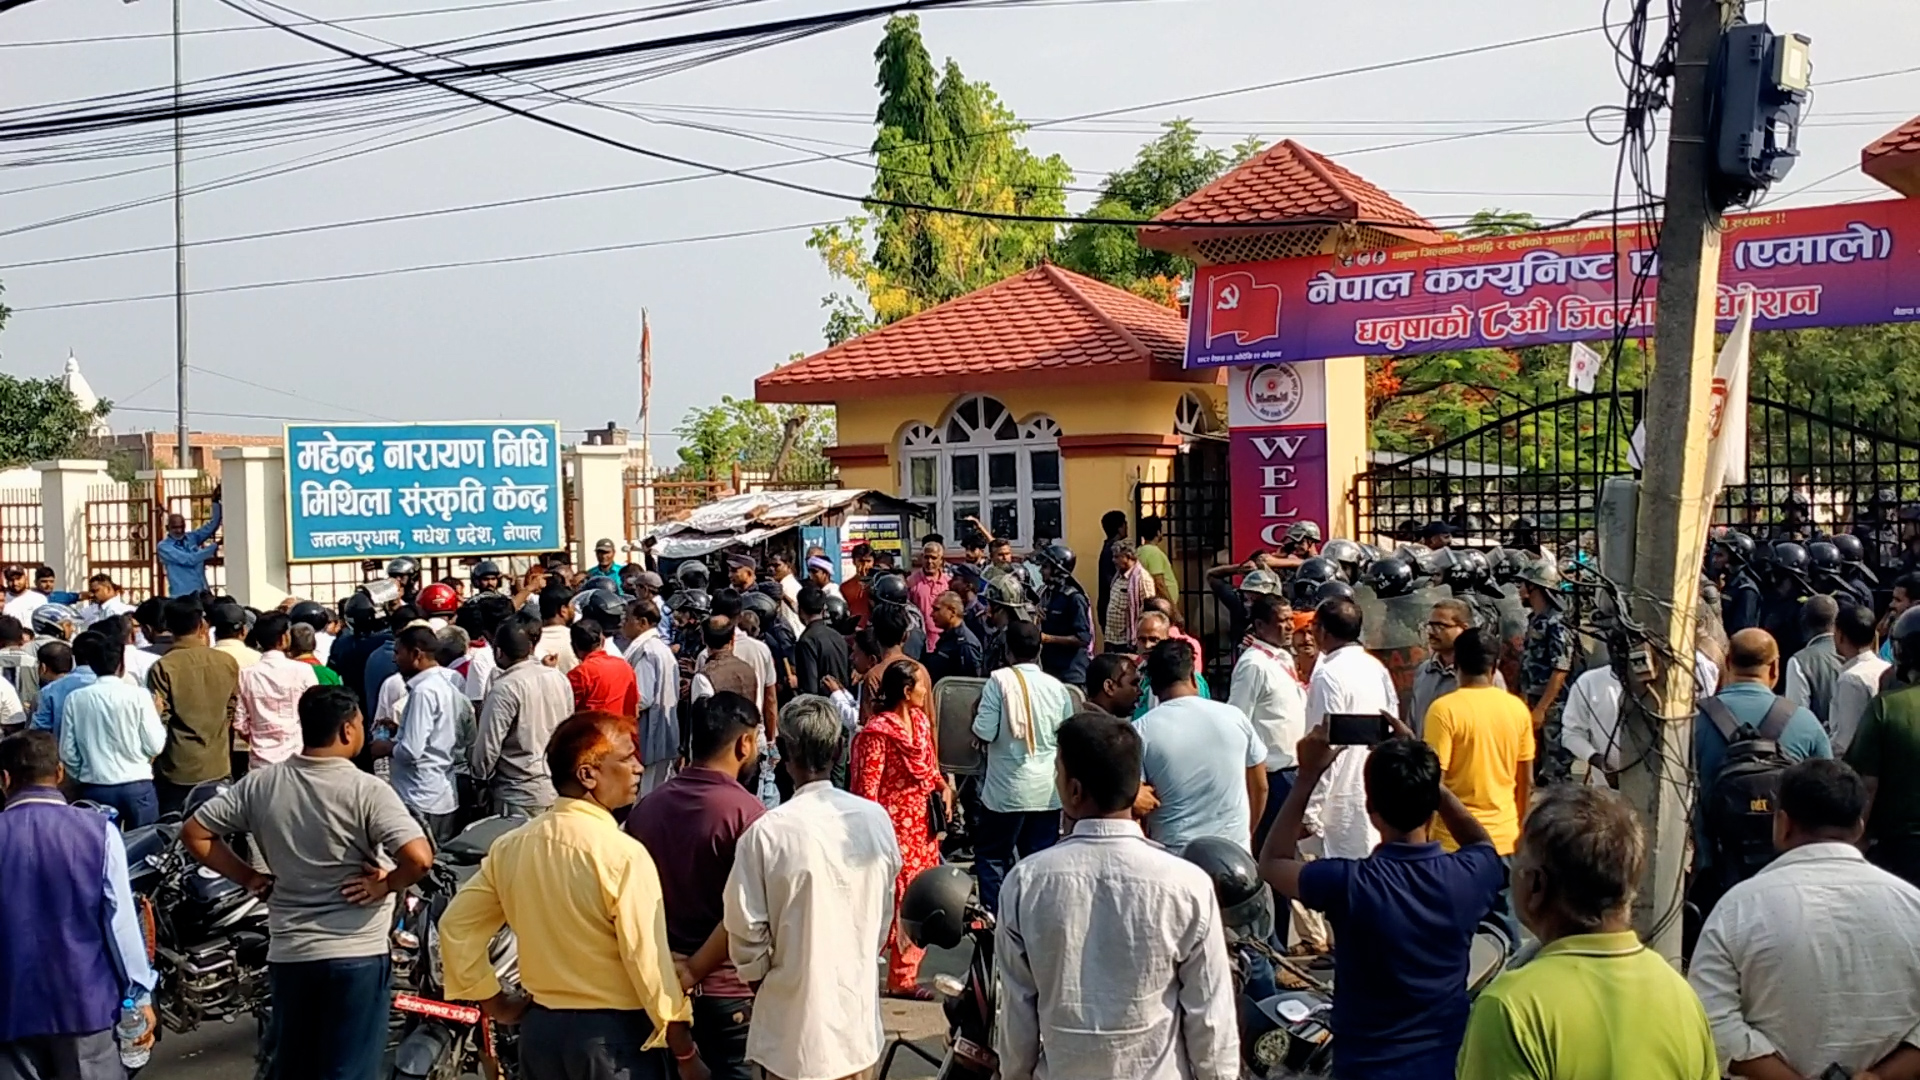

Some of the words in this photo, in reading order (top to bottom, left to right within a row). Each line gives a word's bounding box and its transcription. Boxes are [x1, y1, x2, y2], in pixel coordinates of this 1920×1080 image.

[1735, 222, 1891, 270] (एमाले)
[1307, 271, 1415, 304] नेपाल
[1424, 250, 1614, 295] कम्युनिष्ट
[1355, 304, 1474, 350] धनुषाको
[1557, 294, 1657, 332] जिल्ला
[297, 431, 376, 475] महेन्द्र
[383, 438, 486, 471] नारायण
[493, 428, 549, 468] निधि
[301, 479, 391, 517] मिथिला
[398, 477, 486, 522] संस्कृति
[492, 476, 549, 515] केन्द्र
[1249, 435, 1308, 547] WELC
[309, 528, 406, 552] जनकपुरधाम,
[411, 524, 452, 546] मधेश
[455, 523, 497, 546] प्रदेश,
[502, 520, 543, 542] नेपाल
